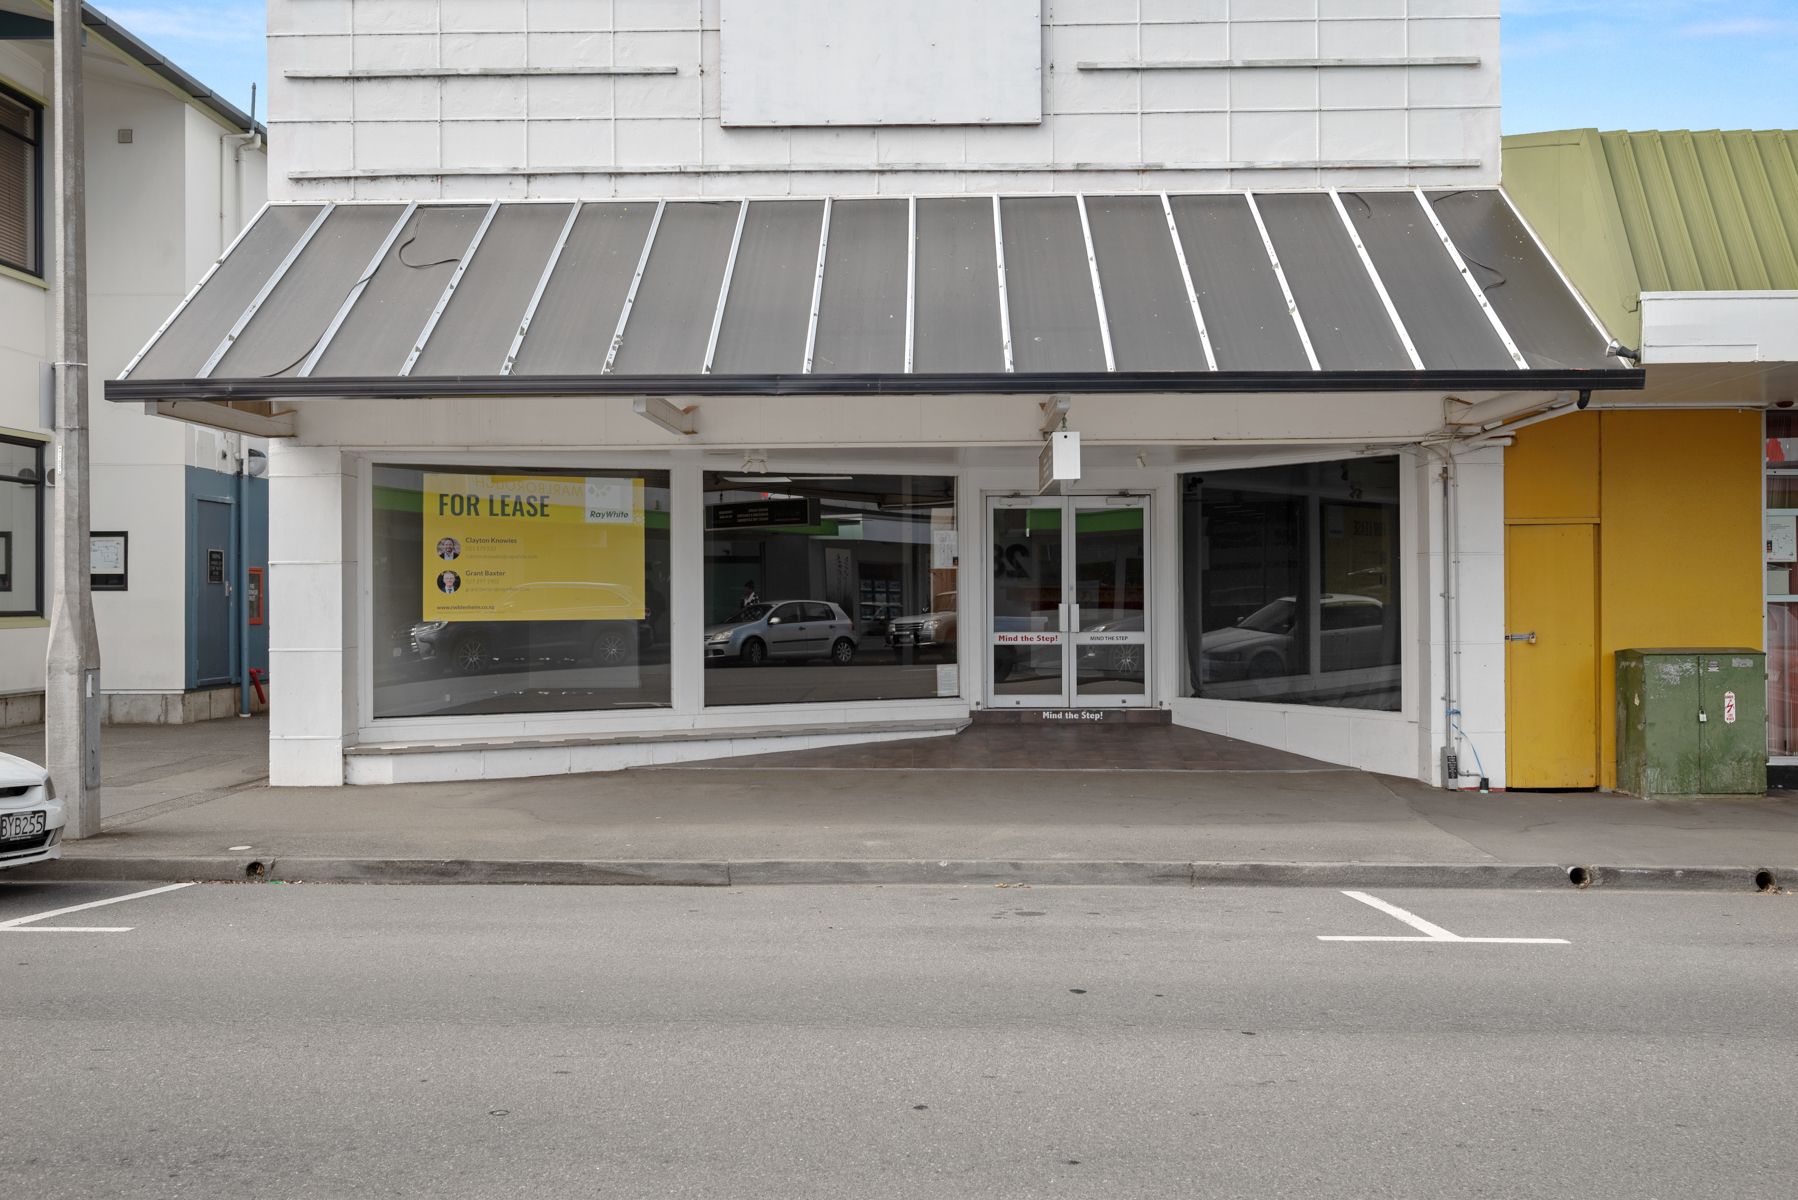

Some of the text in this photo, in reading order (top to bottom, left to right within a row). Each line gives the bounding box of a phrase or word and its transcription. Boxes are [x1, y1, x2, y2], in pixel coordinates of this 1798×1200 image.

[438, 493, 550, 518] FOR LEASE
[998, 634, 1058, 643] Mind the Step!
[1042, 711, 1103, 721] Mind the Step!
[1, 815, 43, 837] BYB255
